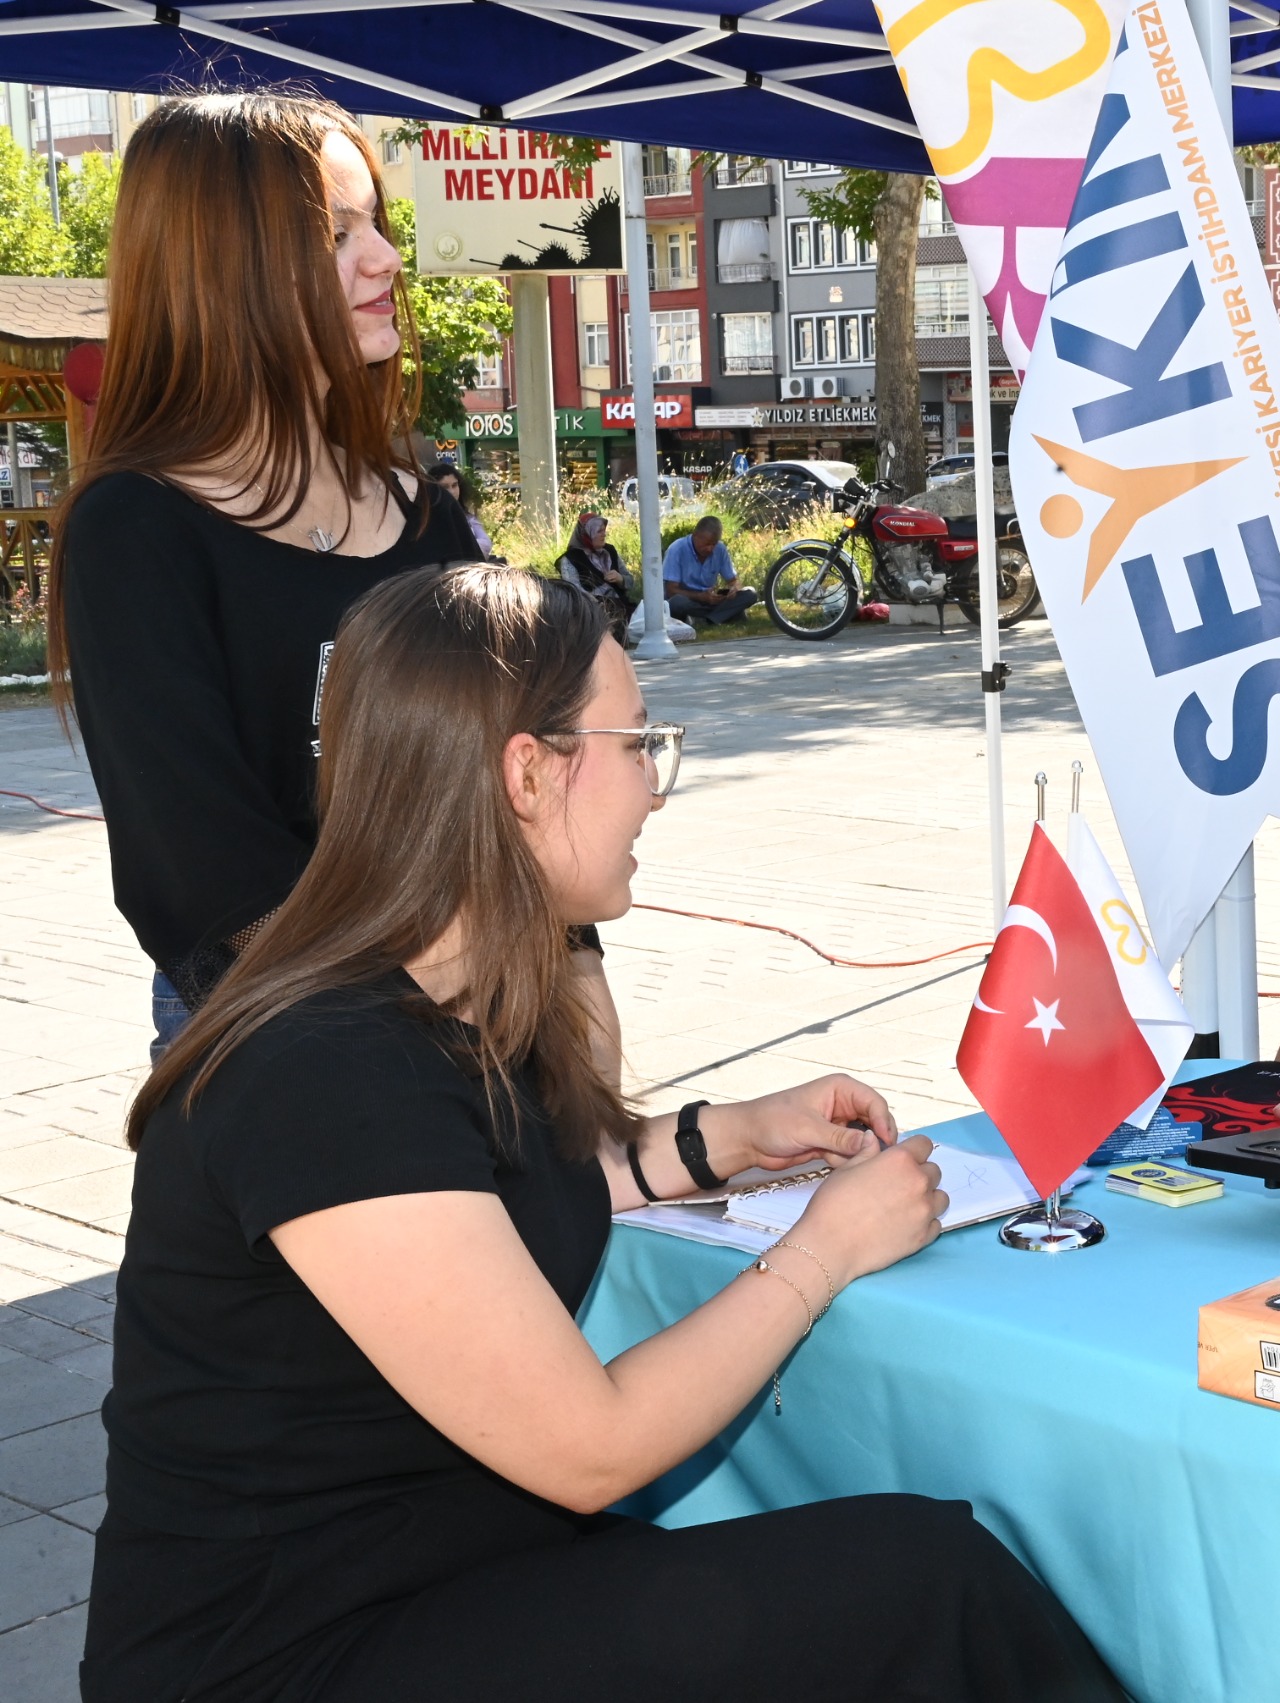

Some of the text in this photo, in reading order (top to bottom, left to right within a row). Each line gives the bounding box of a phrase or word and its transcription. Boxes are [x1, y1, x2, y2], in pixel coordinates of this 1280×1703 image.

[1131, 0, 1195, 133] MERKEZİ
[445, 168, 594, 201] MEYDANI
[1177, 136, 1237, 285] İSTİHDAM
[1223, 284, 1278, 418] KARİYER
[605, 401, 683, 421] KAAP
[764, 408, 804, 424] YILDIZ
[809, 404, 877, 423] ETLİEKMEK
